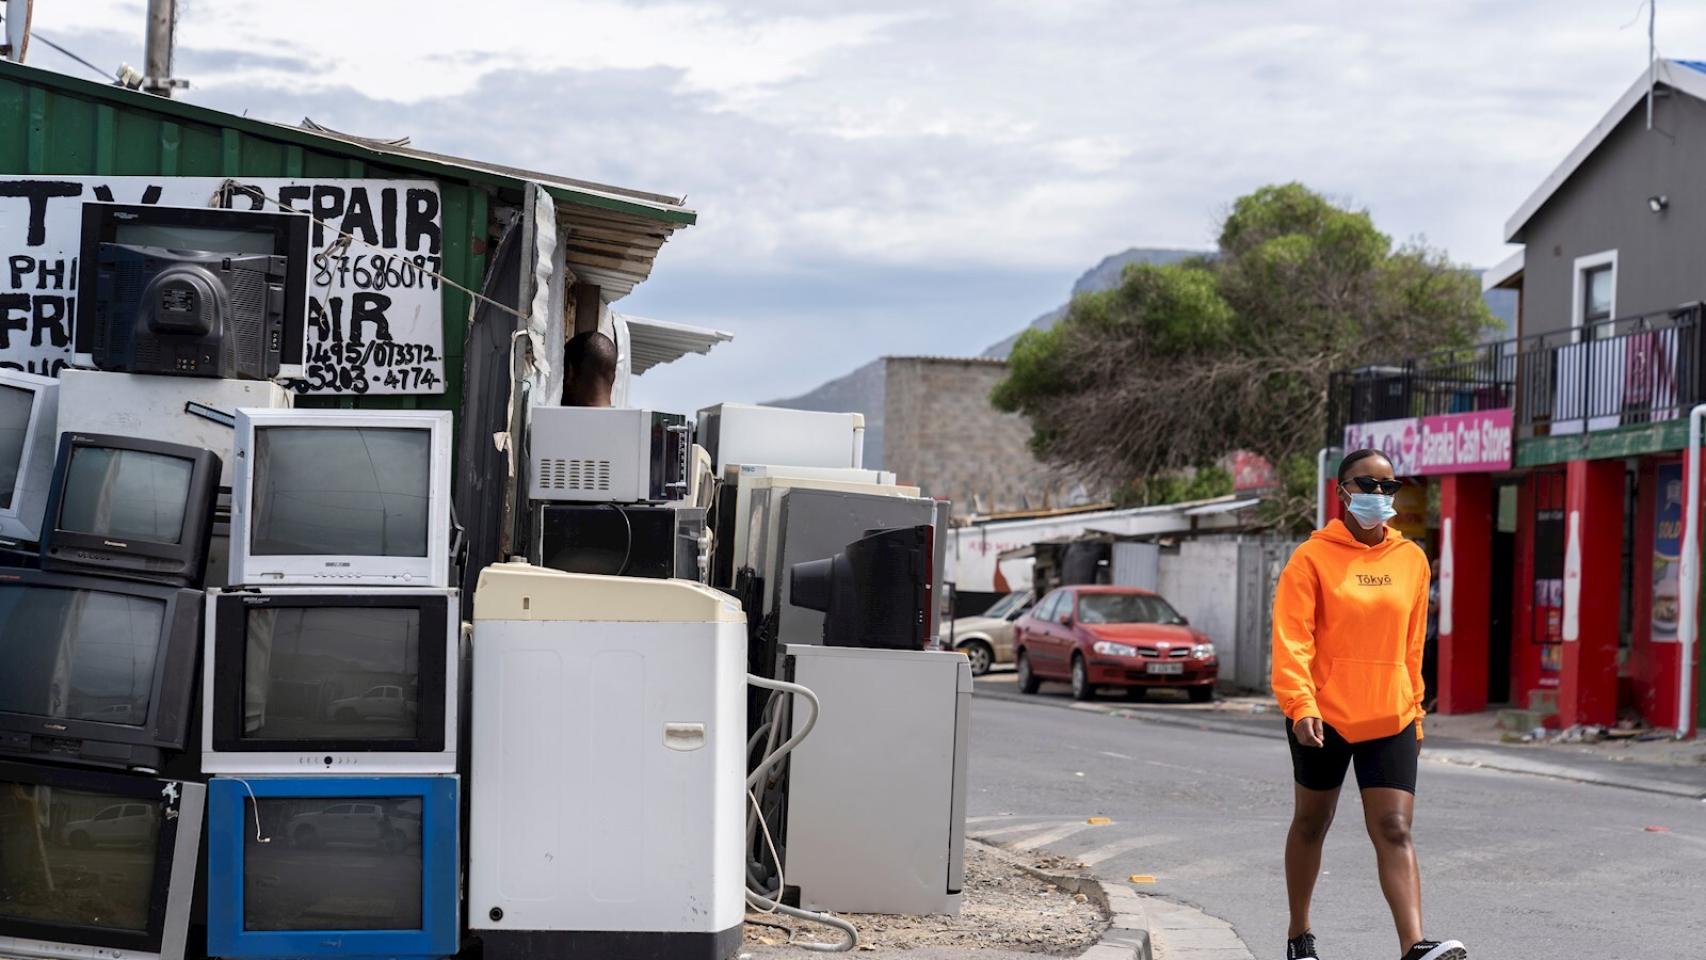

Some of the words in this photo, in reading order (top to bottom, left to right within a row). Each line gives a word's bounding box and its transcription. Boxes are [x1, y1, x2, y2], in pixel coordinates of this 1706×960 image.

[0, 180, 162, 246] T
[1422, 421, 1455, 466] Baraka
[1456, 418, 1480, 464] Cash
[1481, 418, 1510, 462] Store
